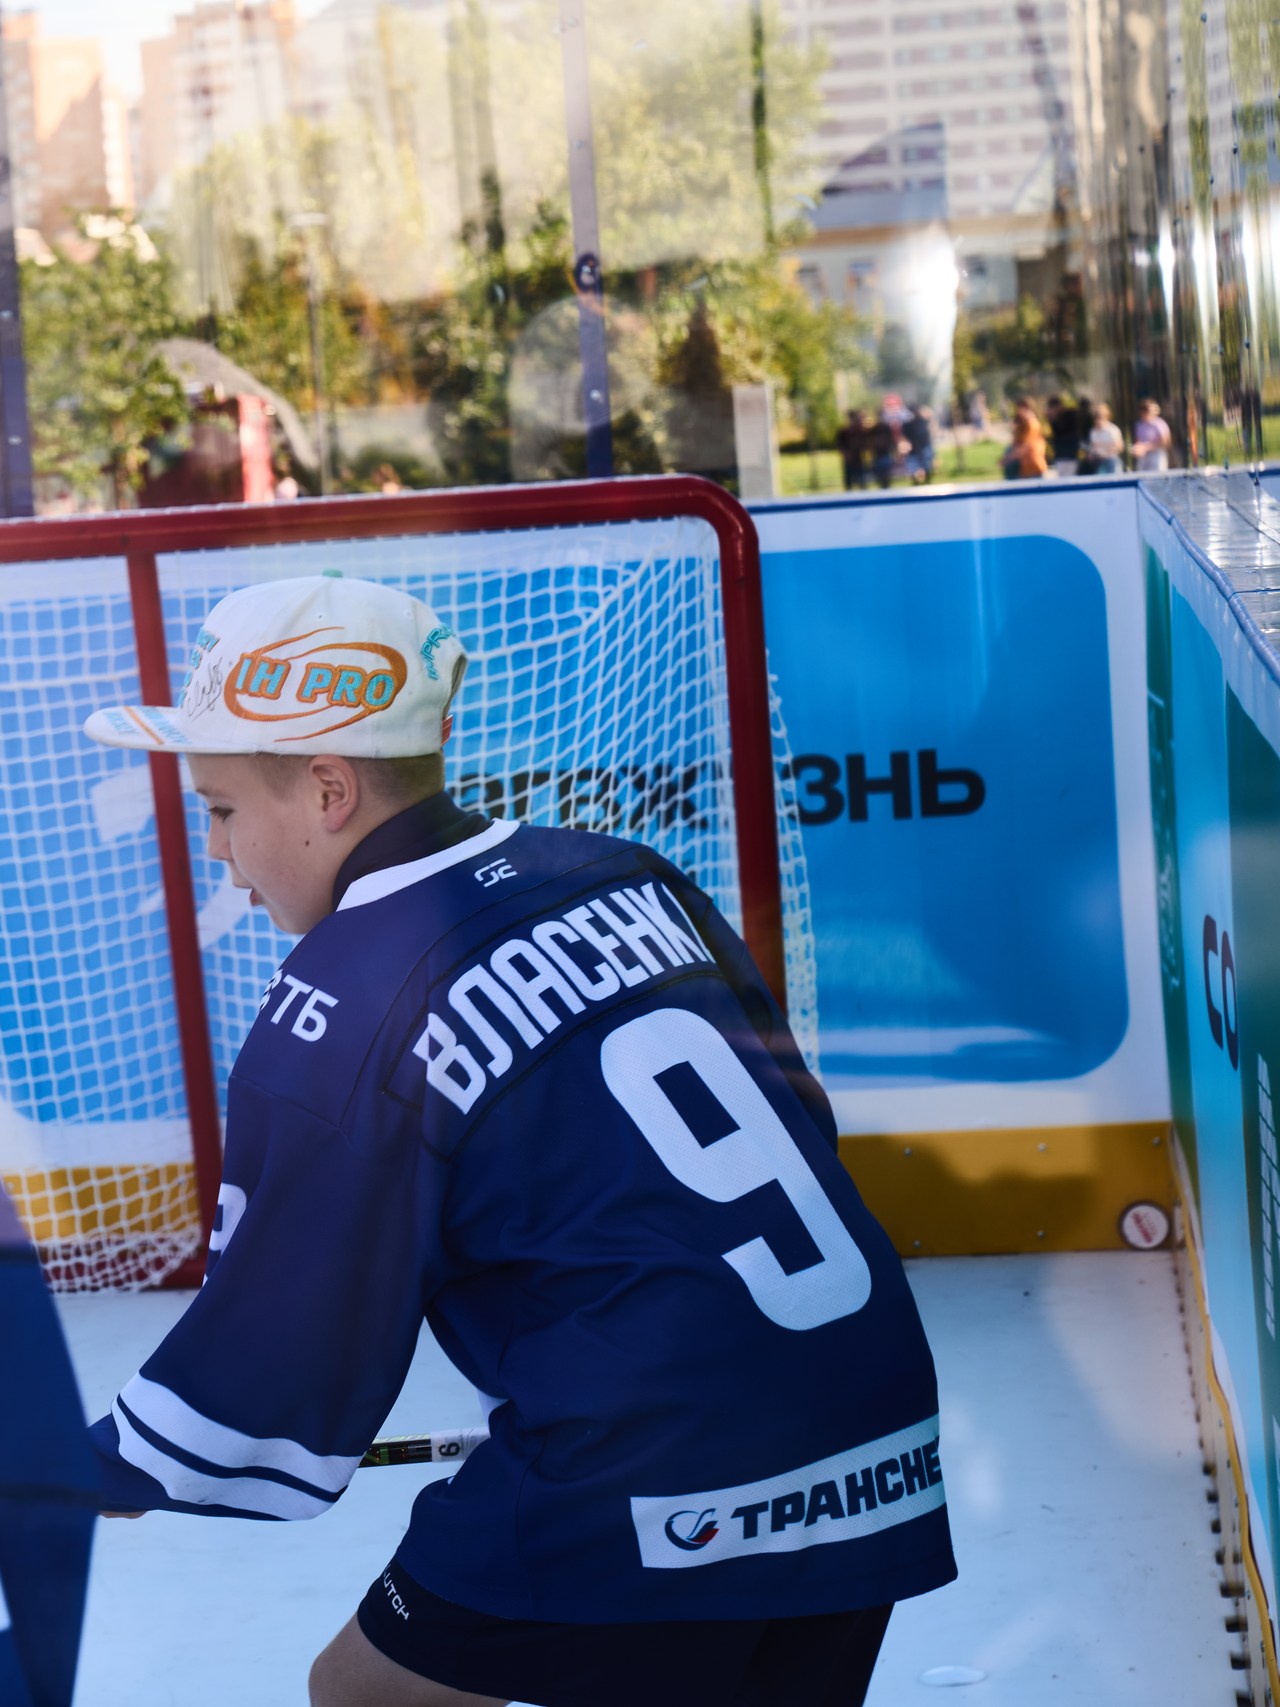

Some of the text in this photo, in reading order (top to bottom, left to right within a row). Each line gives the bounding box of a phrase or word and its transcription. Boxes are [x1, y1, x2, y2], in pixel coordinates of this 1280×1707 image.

[233, 653, 292, 699] IH
[297, 662, 396, 709] PRO
[412, 881, 717, 1116] ВЛАСЕНК
[600, 1007, 872, 1331] 9
